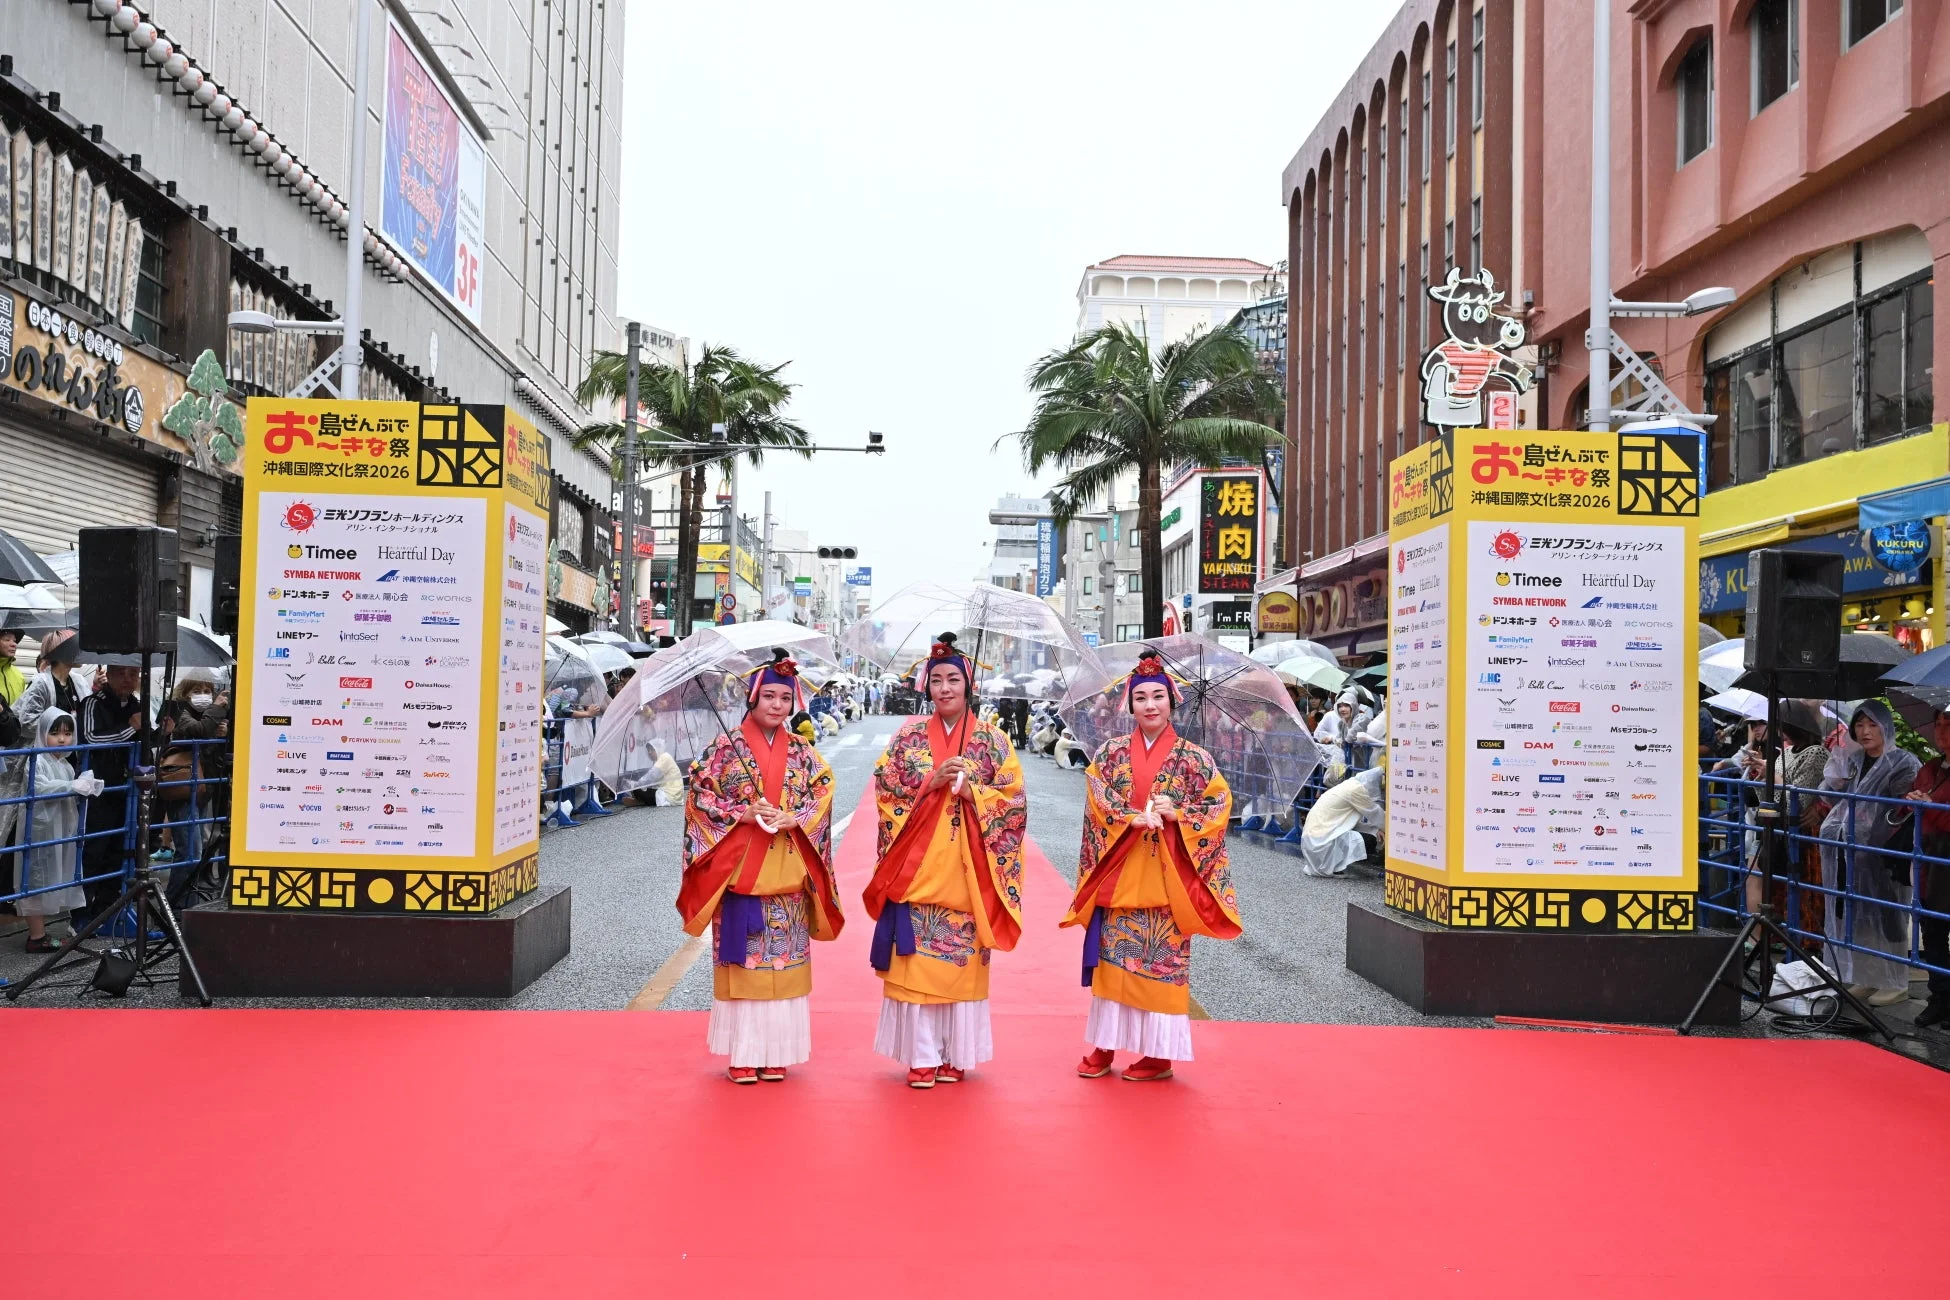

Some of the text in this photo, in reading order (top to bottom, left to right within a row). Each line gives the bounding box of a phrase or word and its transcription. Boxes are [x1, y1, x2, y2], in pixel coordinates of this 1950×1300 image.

[18, 158, 31, 245] タコス
[458, 243, 478, 309] 3F
[14, 342, 126, 423] のれん街
[318, 412, 410, 438] 島ぜんぶで
[1522, 443, 1609, 468] 島ぜんぶで
[263, 460, 410, 480] 沖縄国際文化祭2026
[1471, 490, 1610, 509] 沖縄国際文化祭2026
[323, 509, 464, 525] 三光ソフランホールディングス
[1217, 480, 1256, 560] 焼肉
[1528, 537, 1662, 552] 三光ソフランホールディングス
[1877, 539, 1925, 549] KUKURU
[304, 545, 358, 560] Timee
[377, 546, 456, 565] Heartful Day
[1203, 562, 1252, 576] YAKINIKU
[1843, 556, 1874, 575] AWA
[284, 570, 361, 581] SYMBA NETWORK
[1512, 573, 1562, 588] Timee
[1581, 573, 1655, 592] Heartful Day
[1726, 568, 1748, 595] KU
[1203, 578, 1251, 589] STEAK
[355, 593, 381, 601] 医療法人
[1493, 597, 1566, 608] SYMBA NETWORK
[288, 609, 325, 618] FamilyMart
[1217, 612, 1232, 623] I'm
[1236, 611, 1252, 623] FR
[1561, 619, 1585, 627] 医療法人
[277, 631, 319, 640] LINEヤフー
[1498, 635, 1533, 643] FamilyMart
[1488, 657, 1528, 665] LINEヤフー
[1524, 742, 1554, 750] DAM
